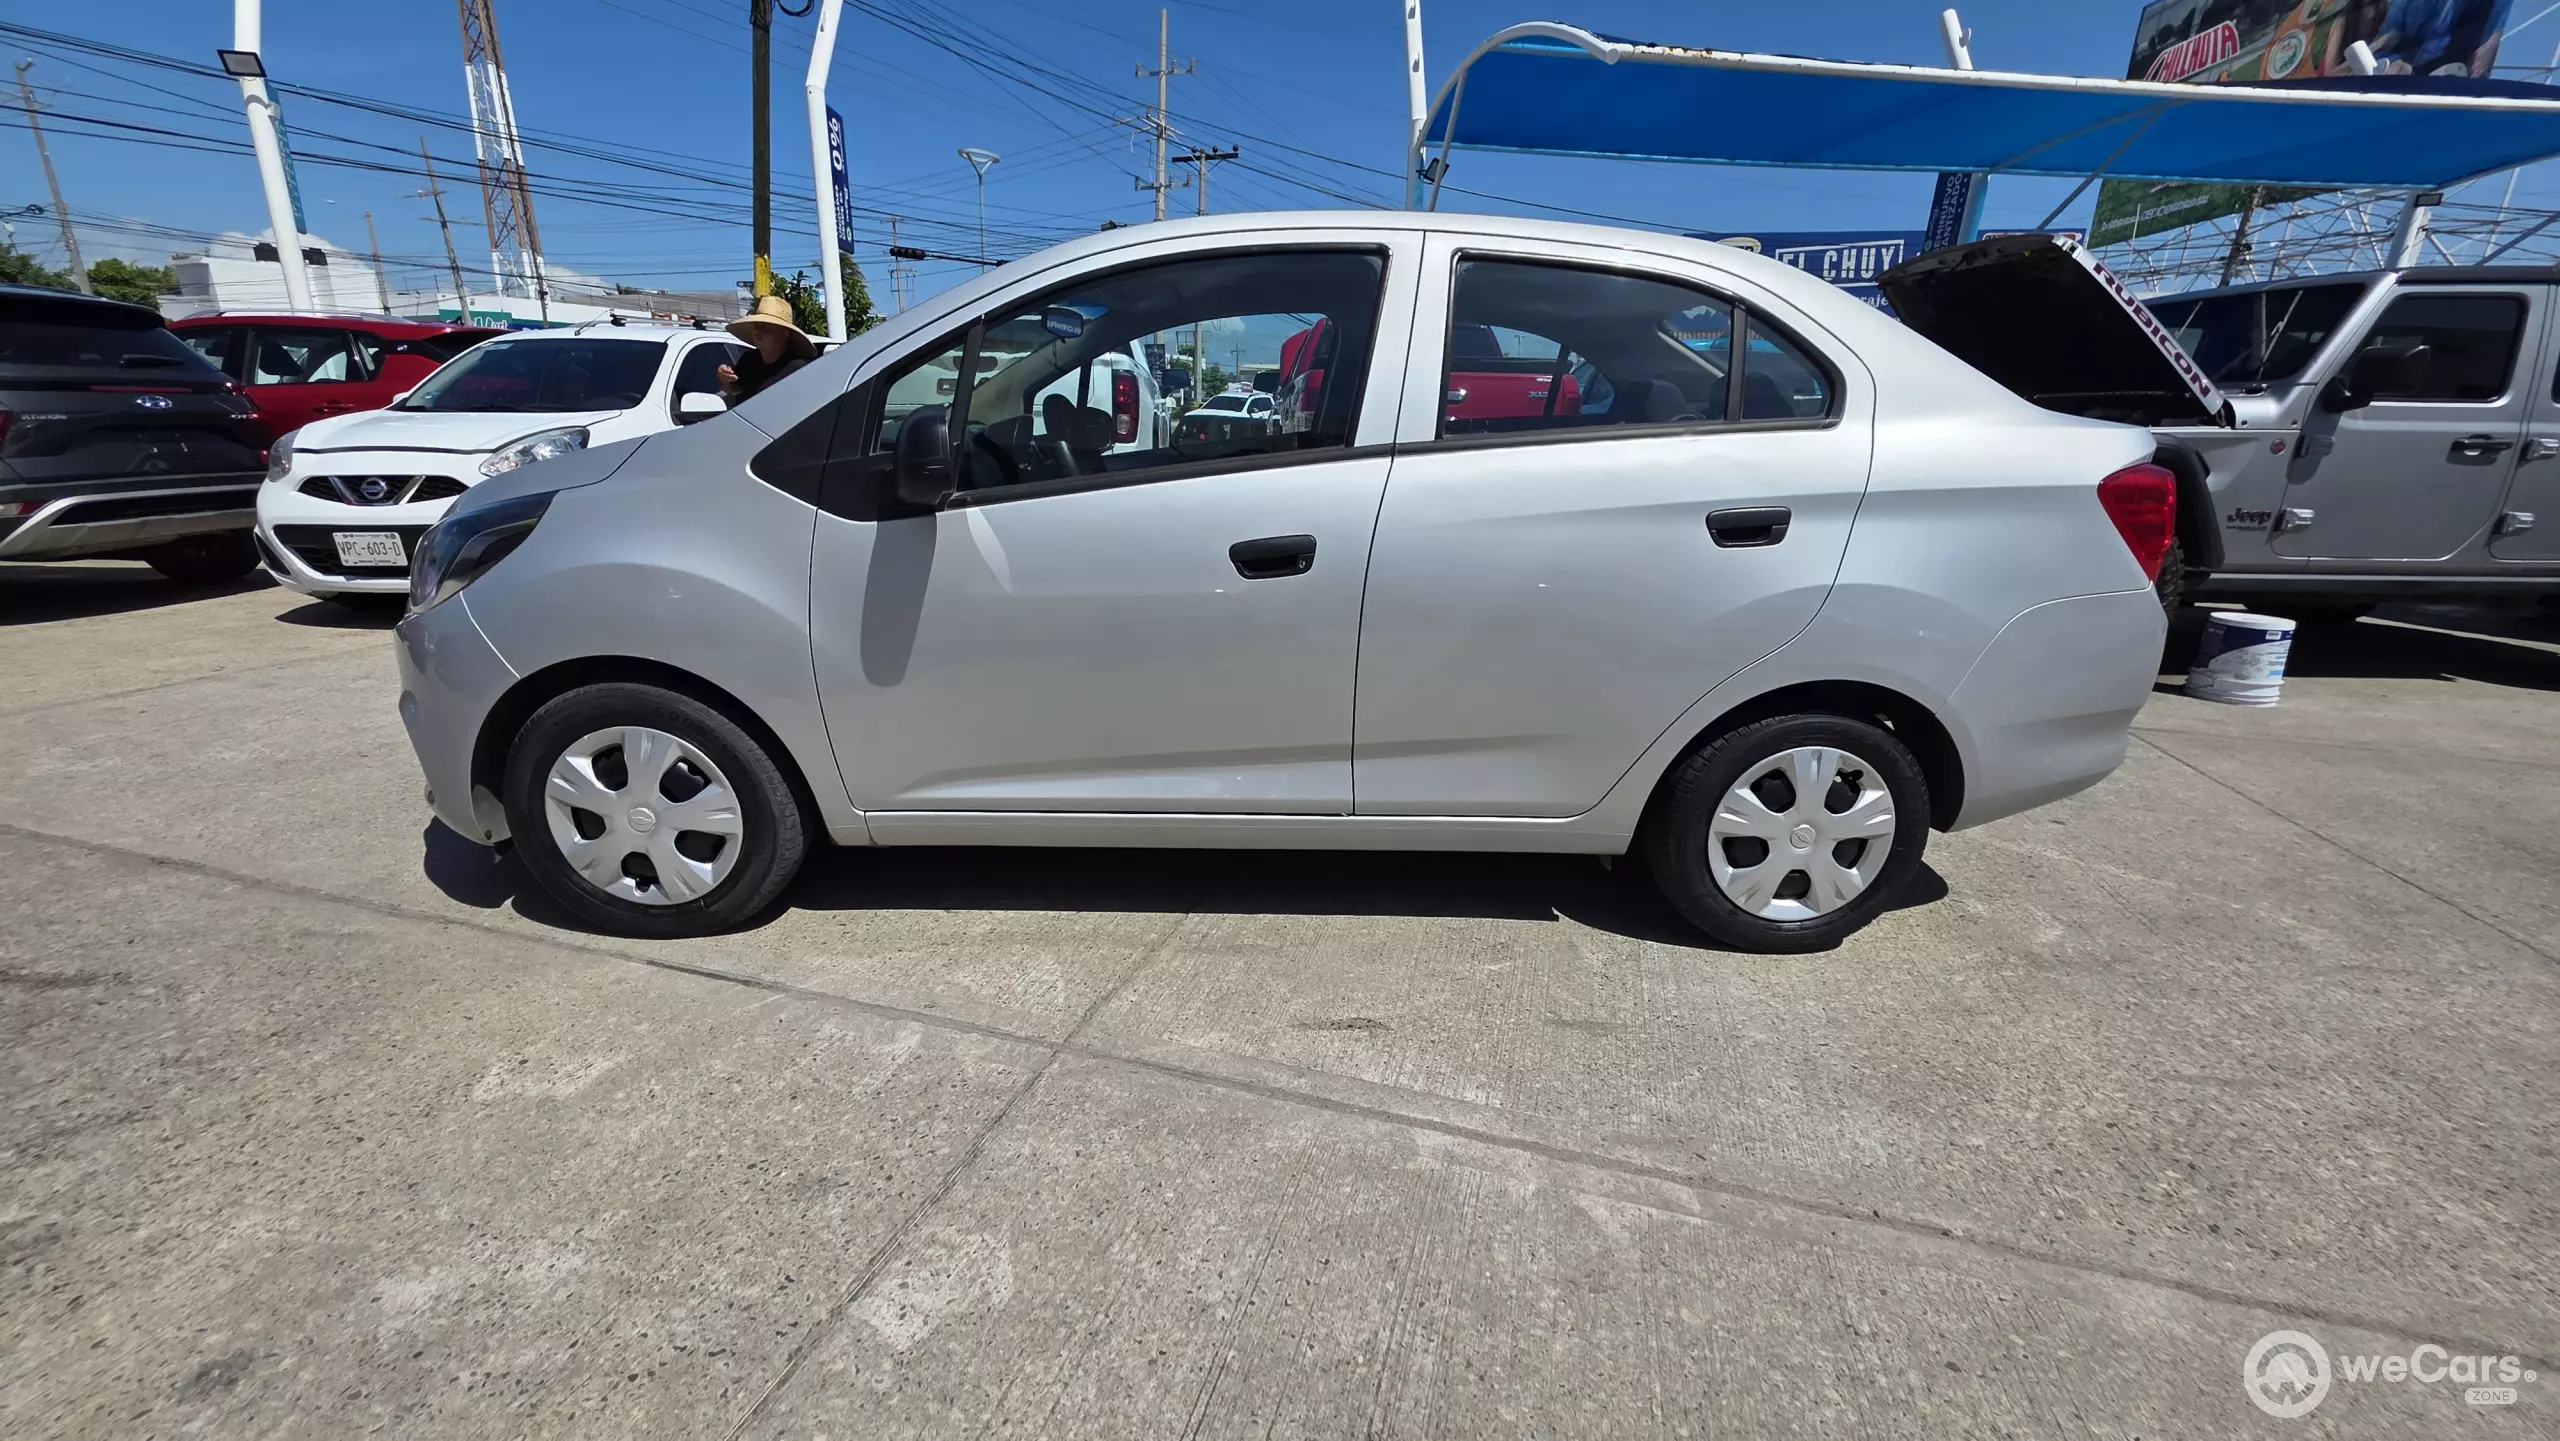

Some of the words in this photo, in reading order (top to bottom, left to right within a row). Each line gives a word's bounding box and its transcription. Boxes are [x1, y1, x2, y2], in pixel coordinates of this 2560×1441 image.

[1822, 245, 1896, 281] CHUY
[2092, 261, 2213, 399] RUBICON
[337, 541, 402, 557] VPC-603-D
